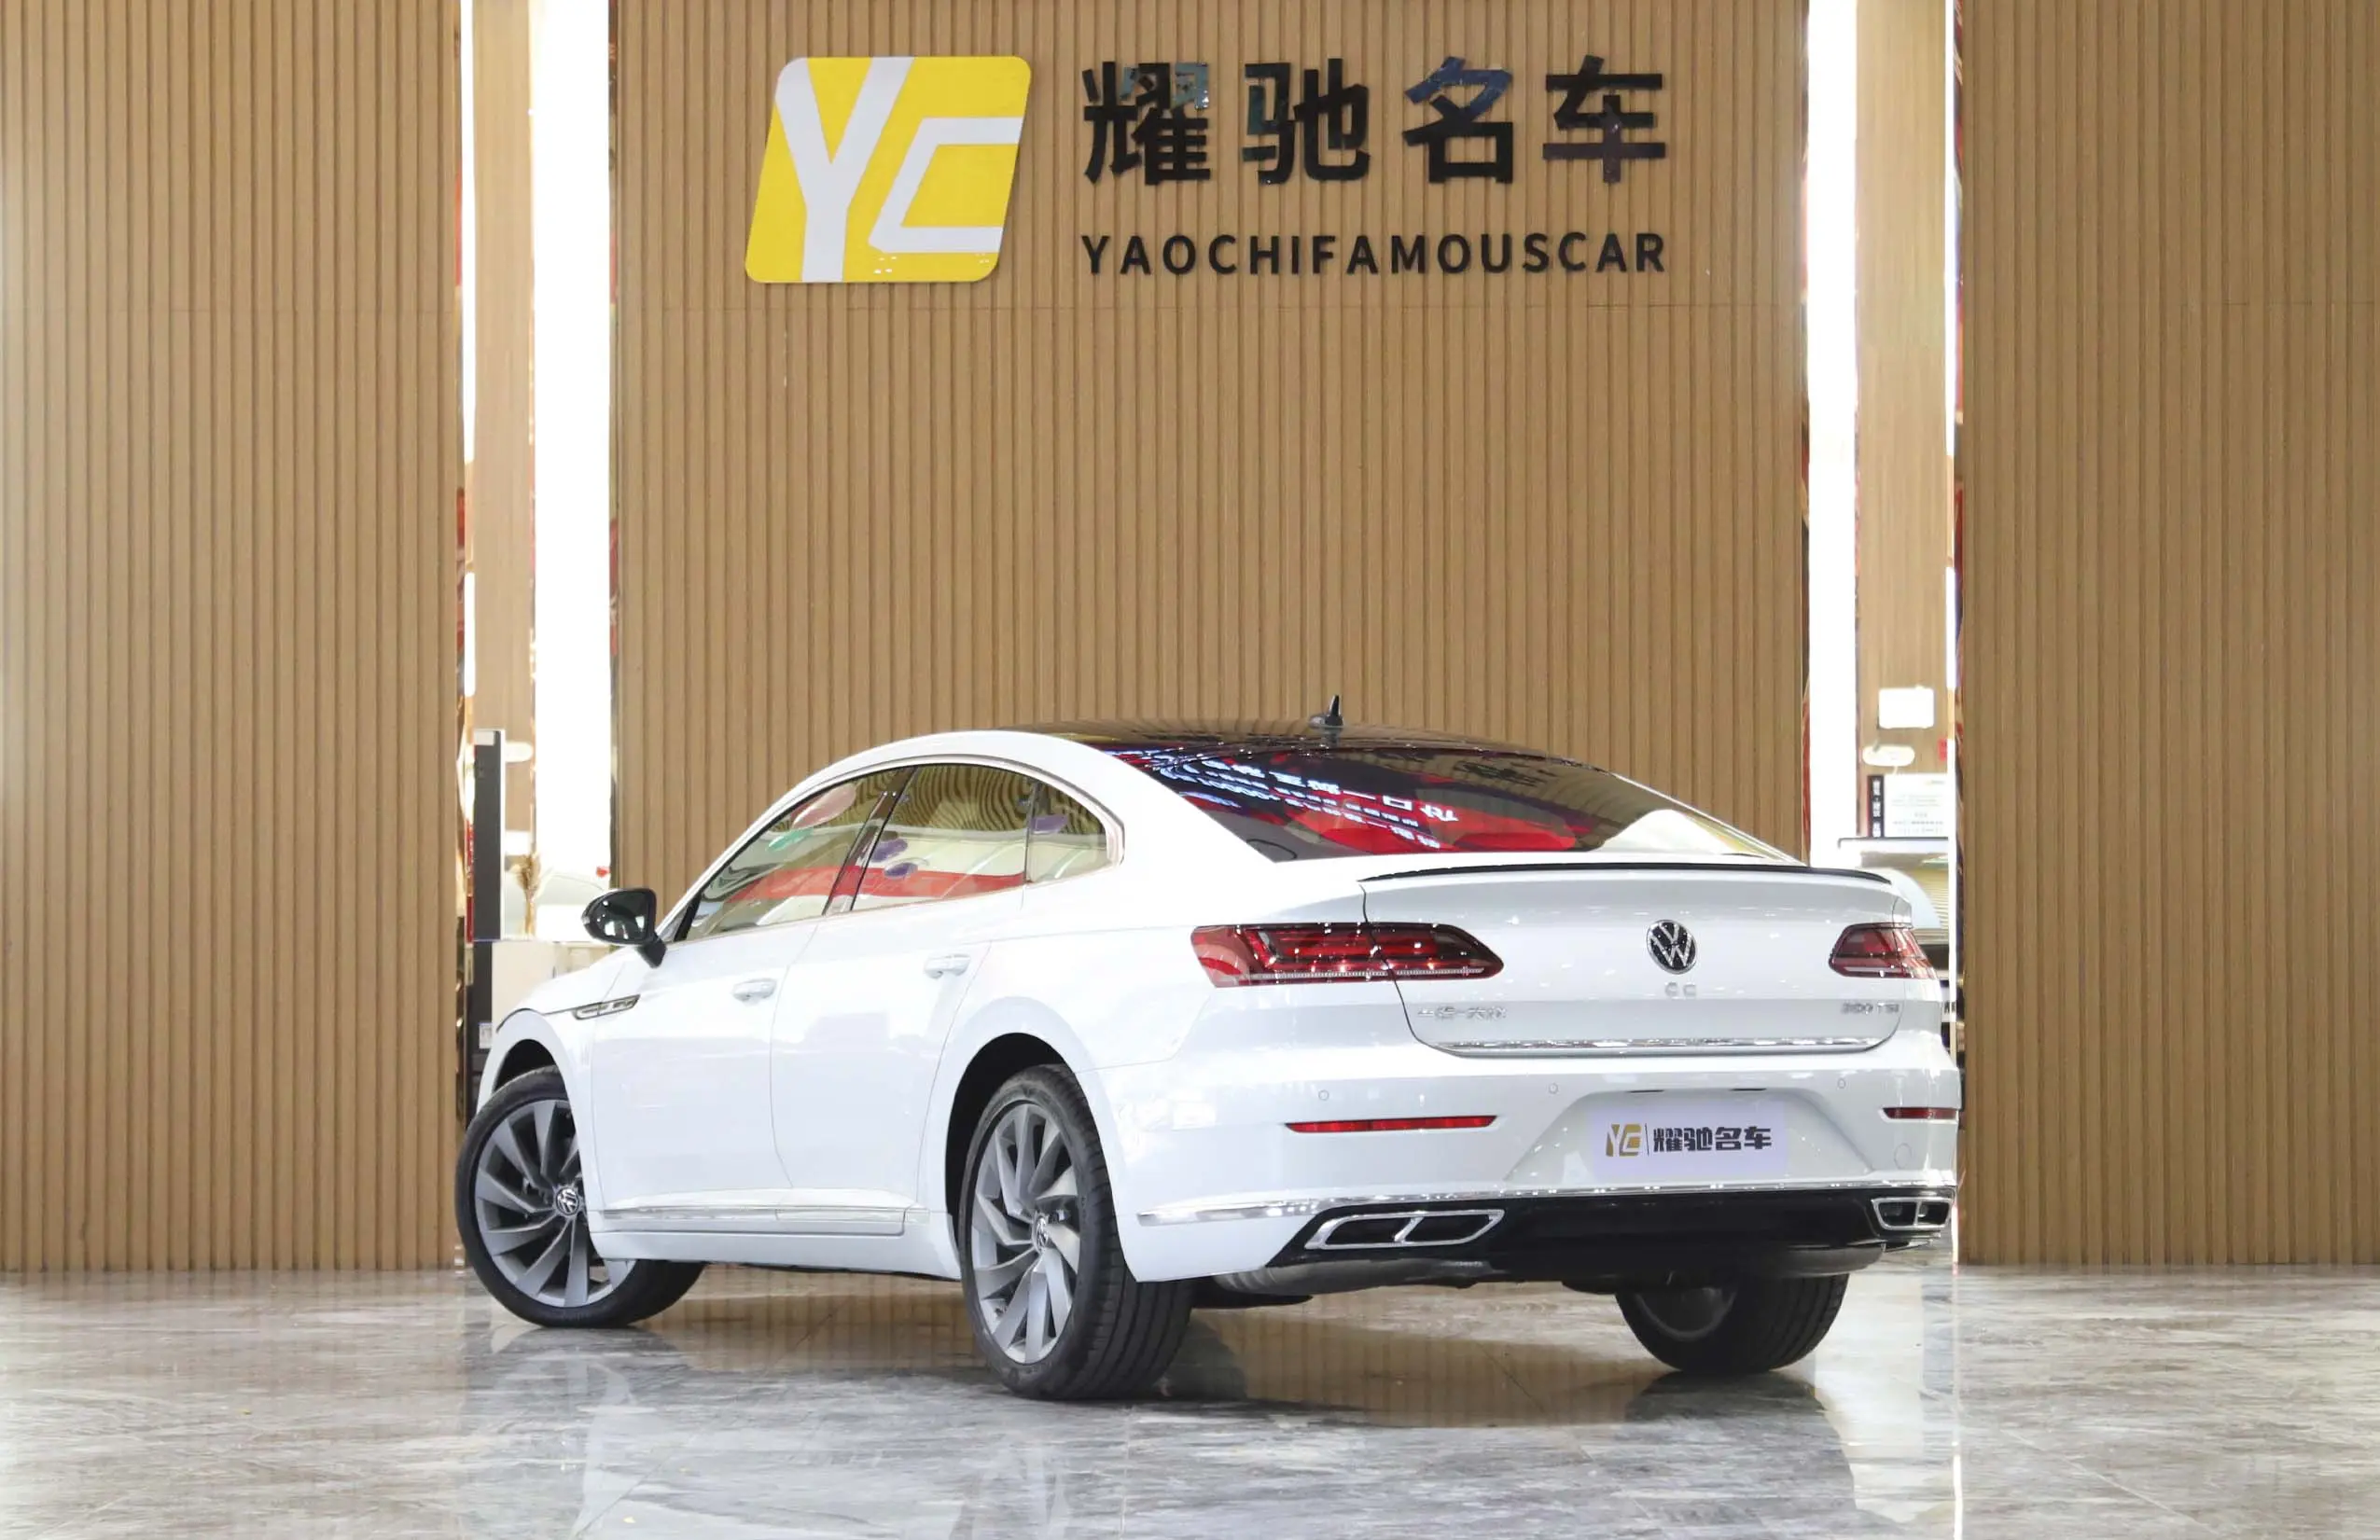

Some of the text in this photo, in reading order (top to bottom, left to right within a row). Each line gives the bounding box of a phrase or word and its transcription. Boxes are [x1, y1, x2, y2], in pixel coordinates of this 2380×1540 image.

[1082, 54, 1666, 185] 耀驰名车
[1081, 230, 1665, 277] YAOCHIFAMOUSCAR
[1652, 1125, 1773, 1153] 耀驰名车
